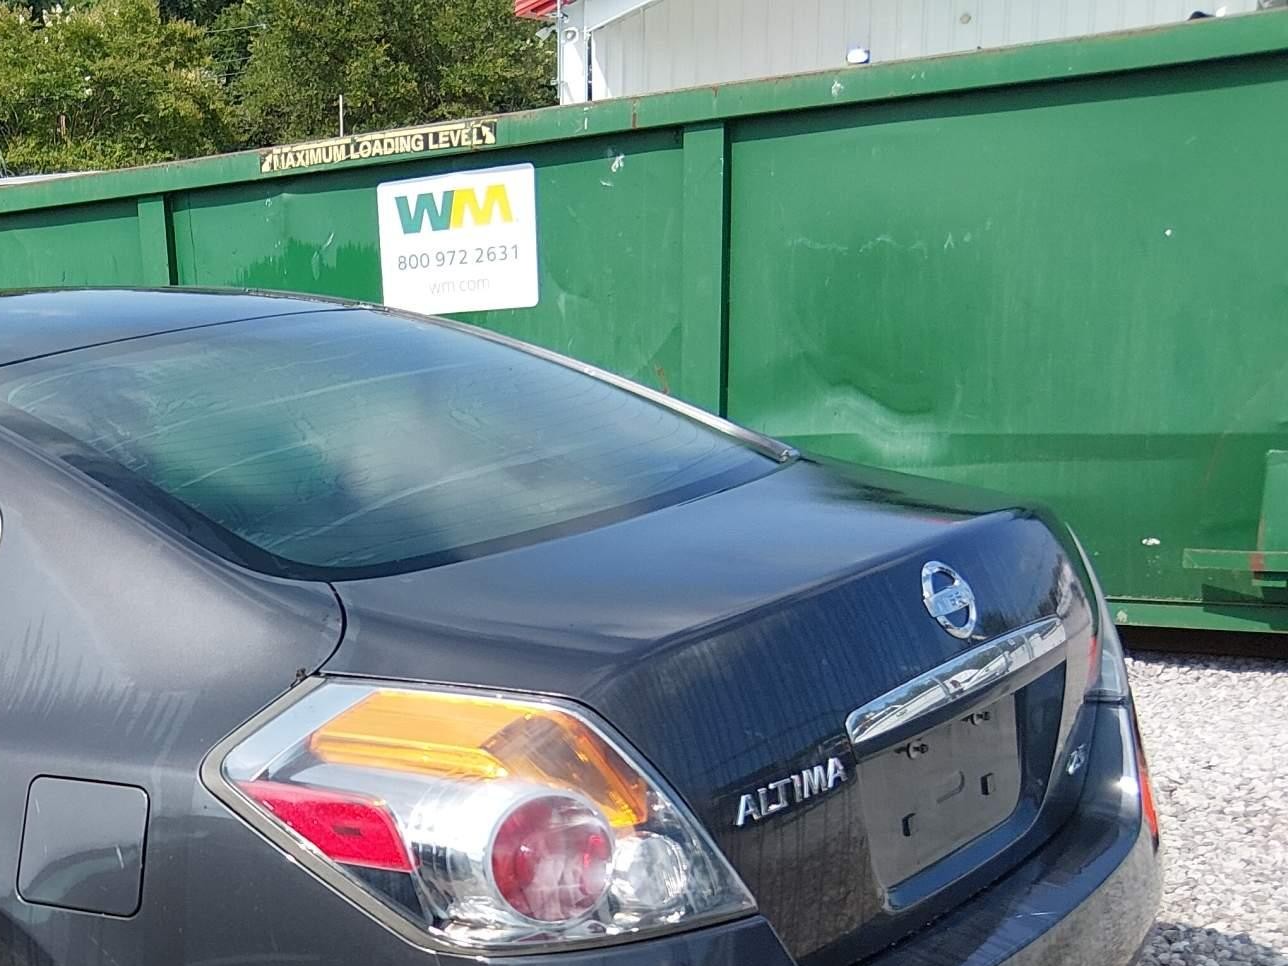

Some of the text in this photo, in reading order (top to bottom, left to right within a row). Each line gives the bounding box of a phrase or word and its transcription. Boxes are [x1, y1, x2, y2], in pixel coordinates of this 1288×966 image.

[272, 127, 484, 171] MAXIMUM LOADING LEVEL
[394, 183, 514, 235] WM
[398, 243, 519, 271] 800 972 2631
[735, 756, 849, 827] ALTIMA
